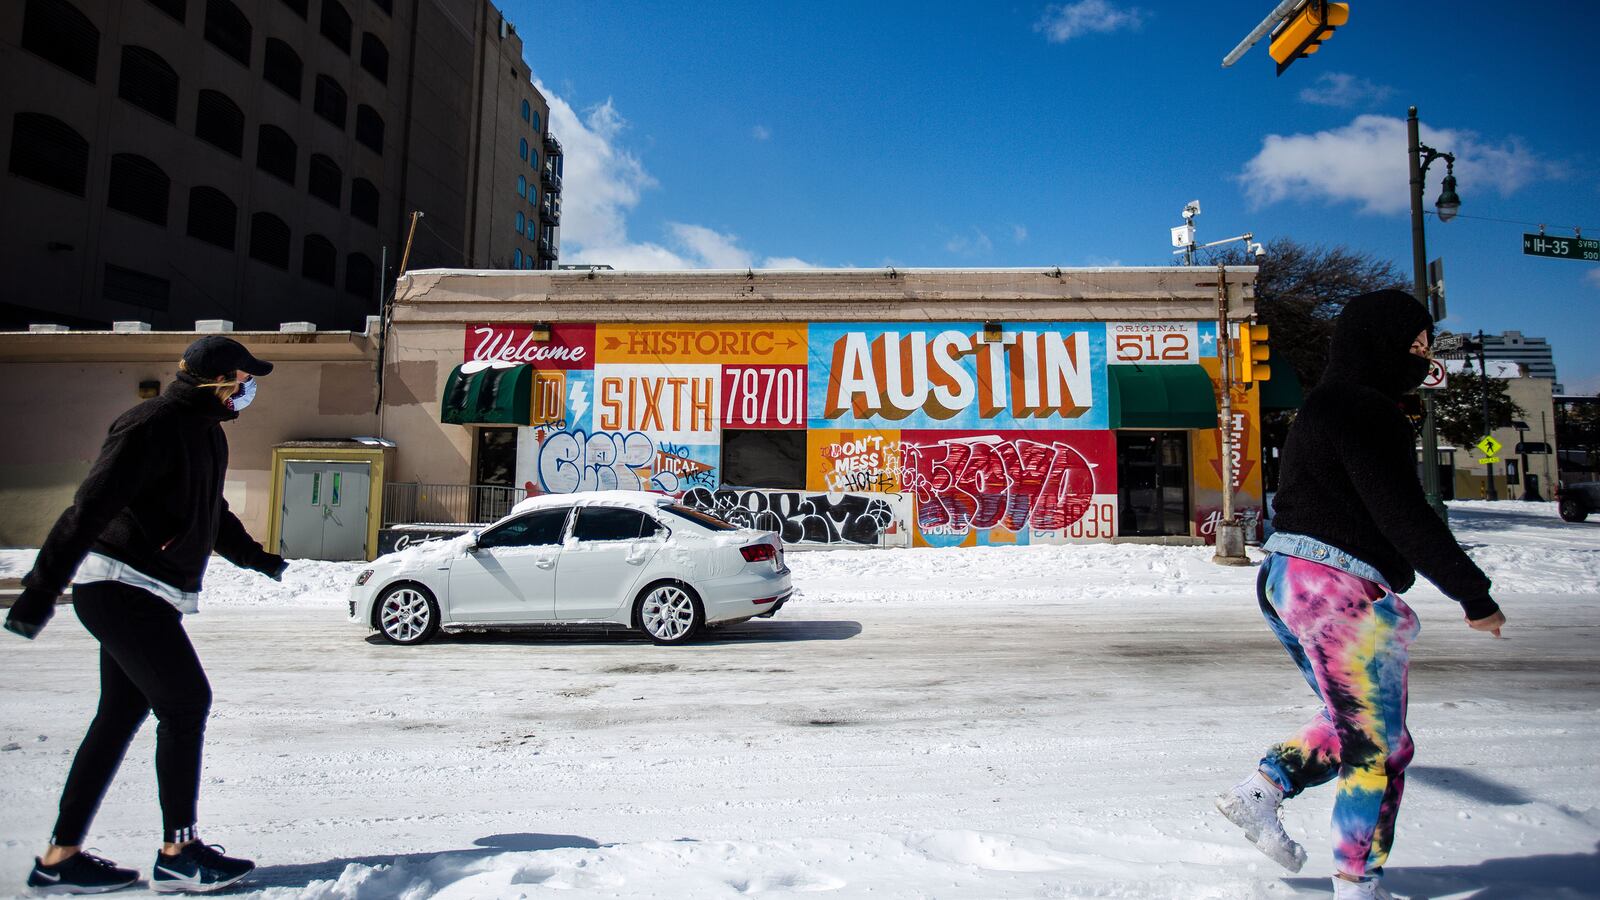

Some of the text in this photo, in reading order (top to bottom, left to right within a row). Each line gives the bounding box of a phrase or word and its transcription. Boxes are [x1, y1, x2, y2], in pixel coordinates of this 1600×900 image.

[1524, 238, 1599, 255] N IH-35 SVRD
[1583, 251, 1599, 260] 500
[1115, 324, 1188, 333] ORIGINAL
[473, 327, 587, 362] Welcome
[627, 331, 774, 356] HISTORIC
[1116, 333, 1189, 361] 512
[824, 330, 1093, 420] AUSTIN
[536, 377, 561, 419] TO
[600, 376, 714, 432] SIXTH
[725, 368, 804, 426] 78701
[660, 441, 690, 459] UNO
[830, 435, 884, 458] DON'T
[656, 453, 699, 475] LOCAL
[835, 452, 879, 473] MESS
